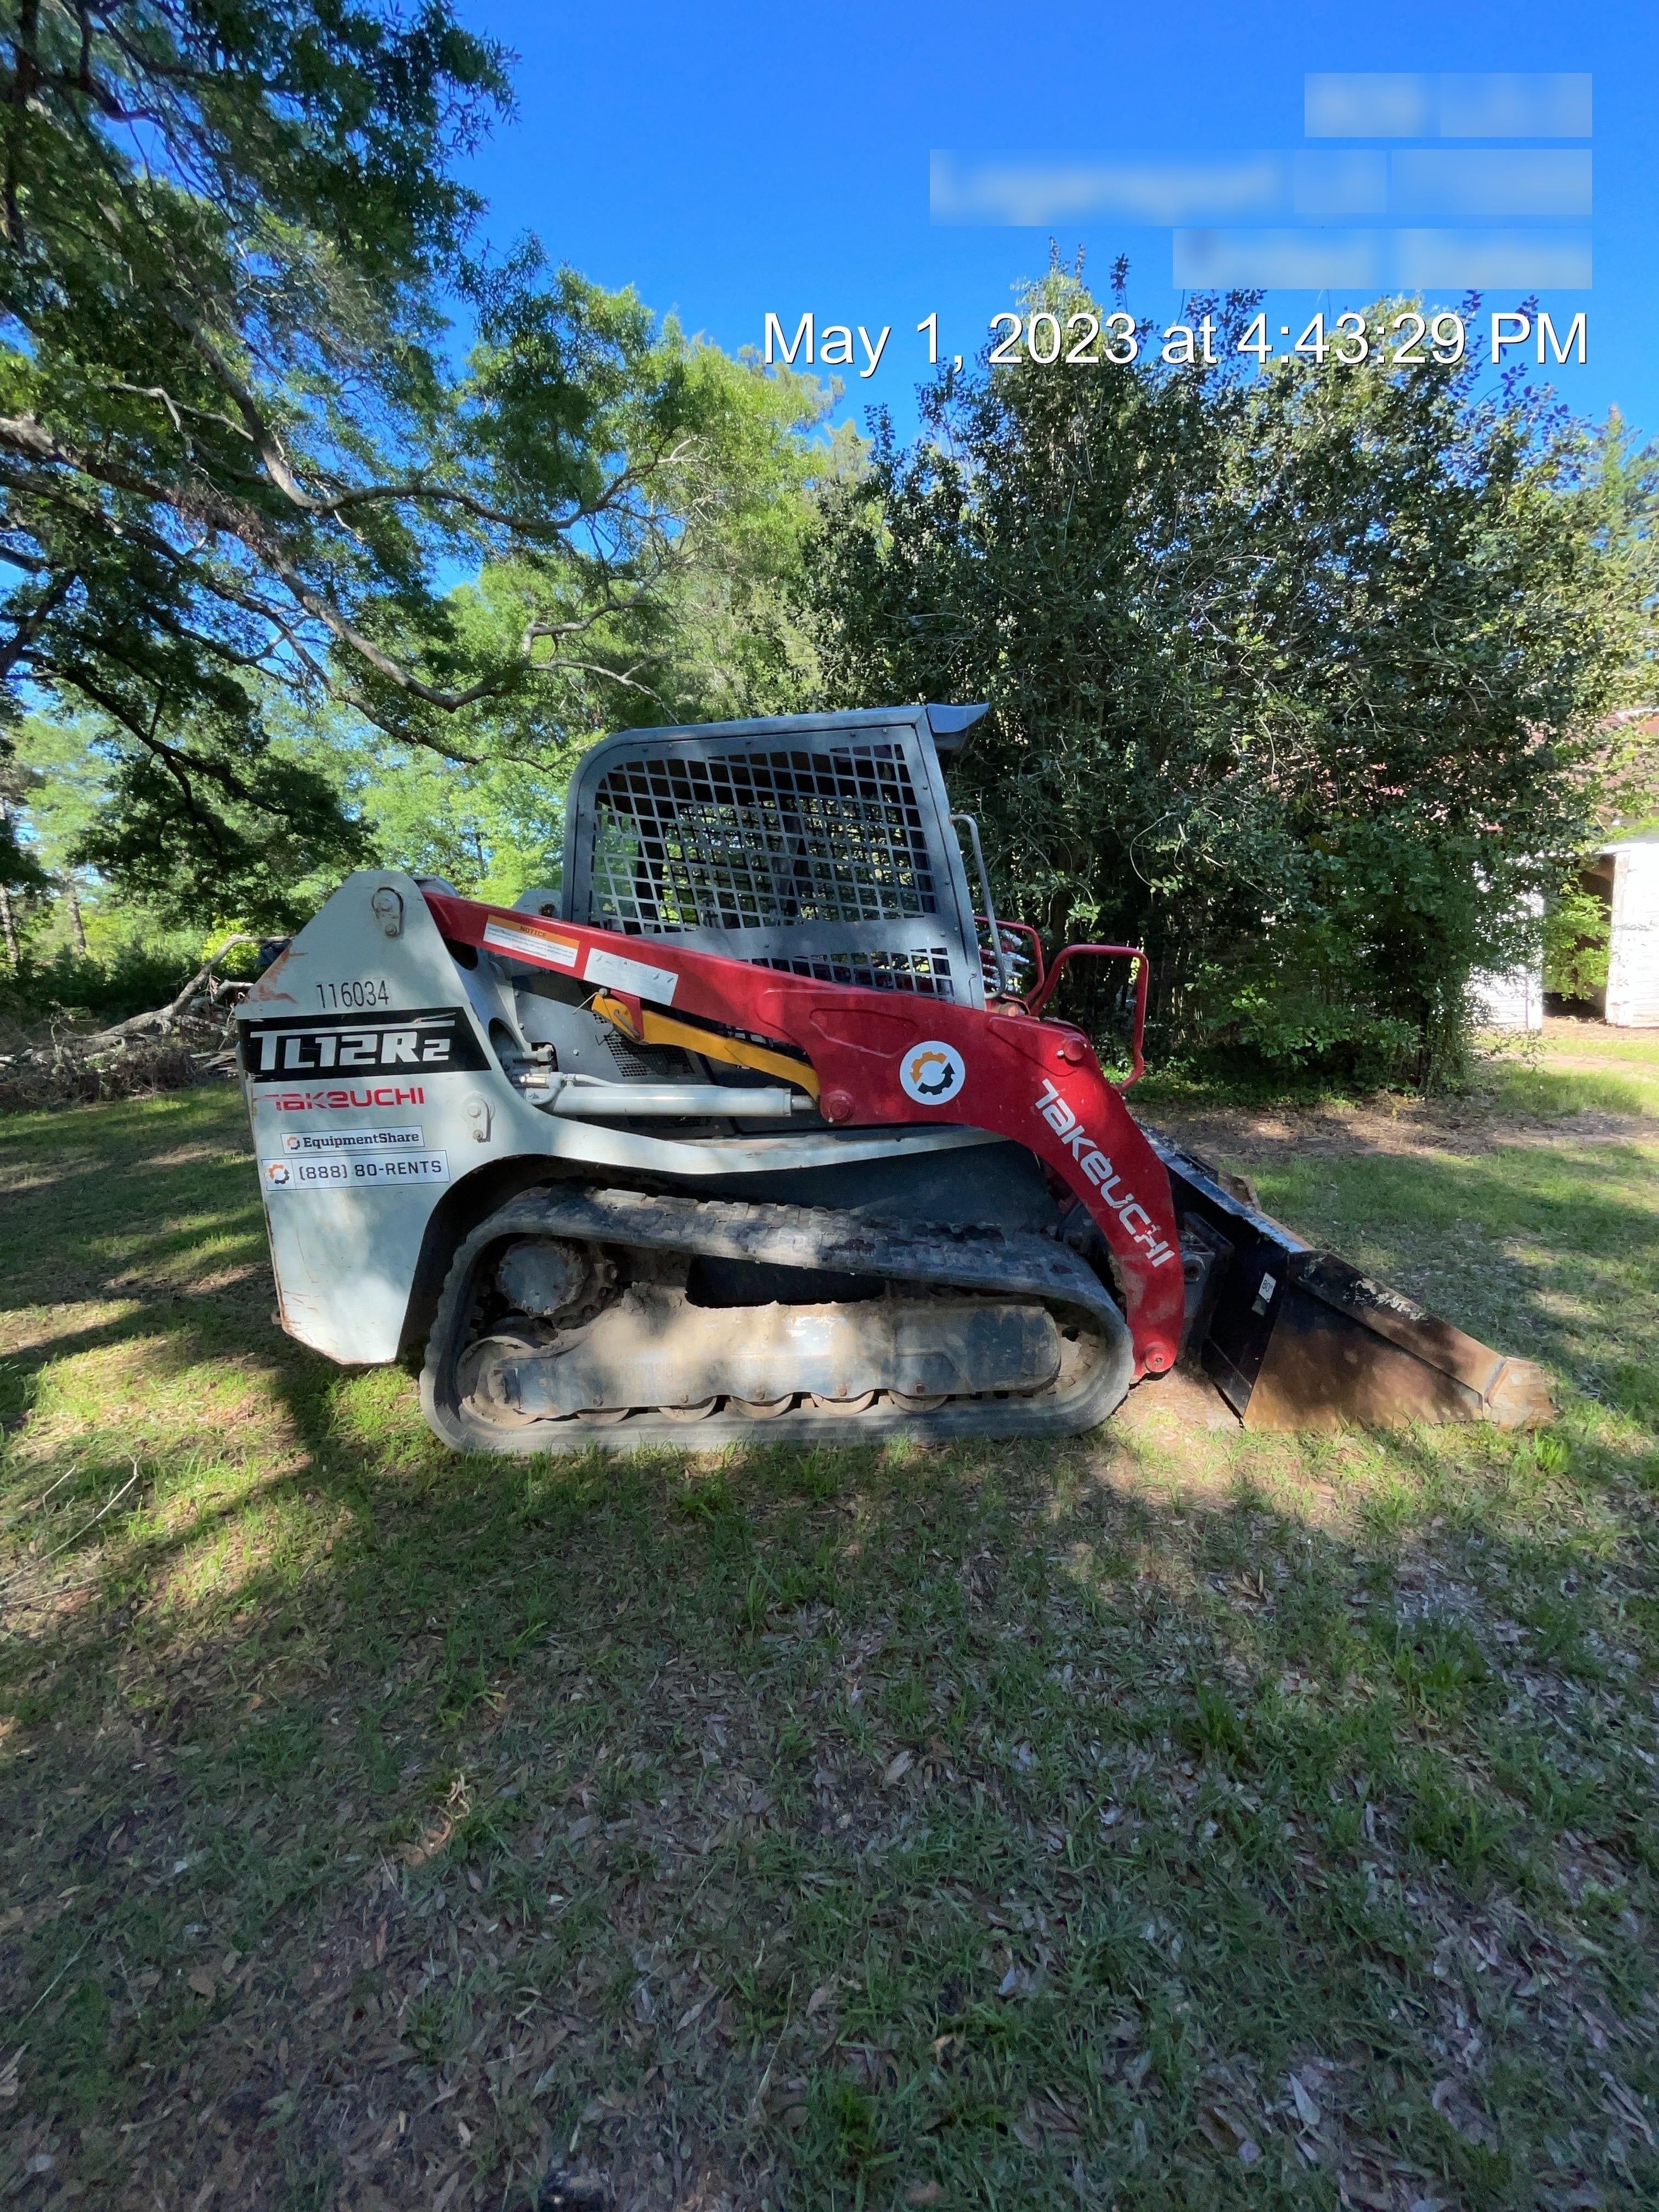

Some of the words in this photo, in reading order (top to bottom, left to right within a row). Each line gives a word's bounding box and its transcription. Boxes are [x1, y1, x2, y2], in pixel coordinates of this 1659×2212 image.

[520, 926, 547, 938] NOTICE
[316, 980, 390, 1009] 116034
[250, 1019, 455, 1071] TL12R2
[303, 1132, 420, 1149] EquipmentShare
[299, 1165, 347, 1181] (888)
[354, 1160, 442, 1177] 80-RENTS
